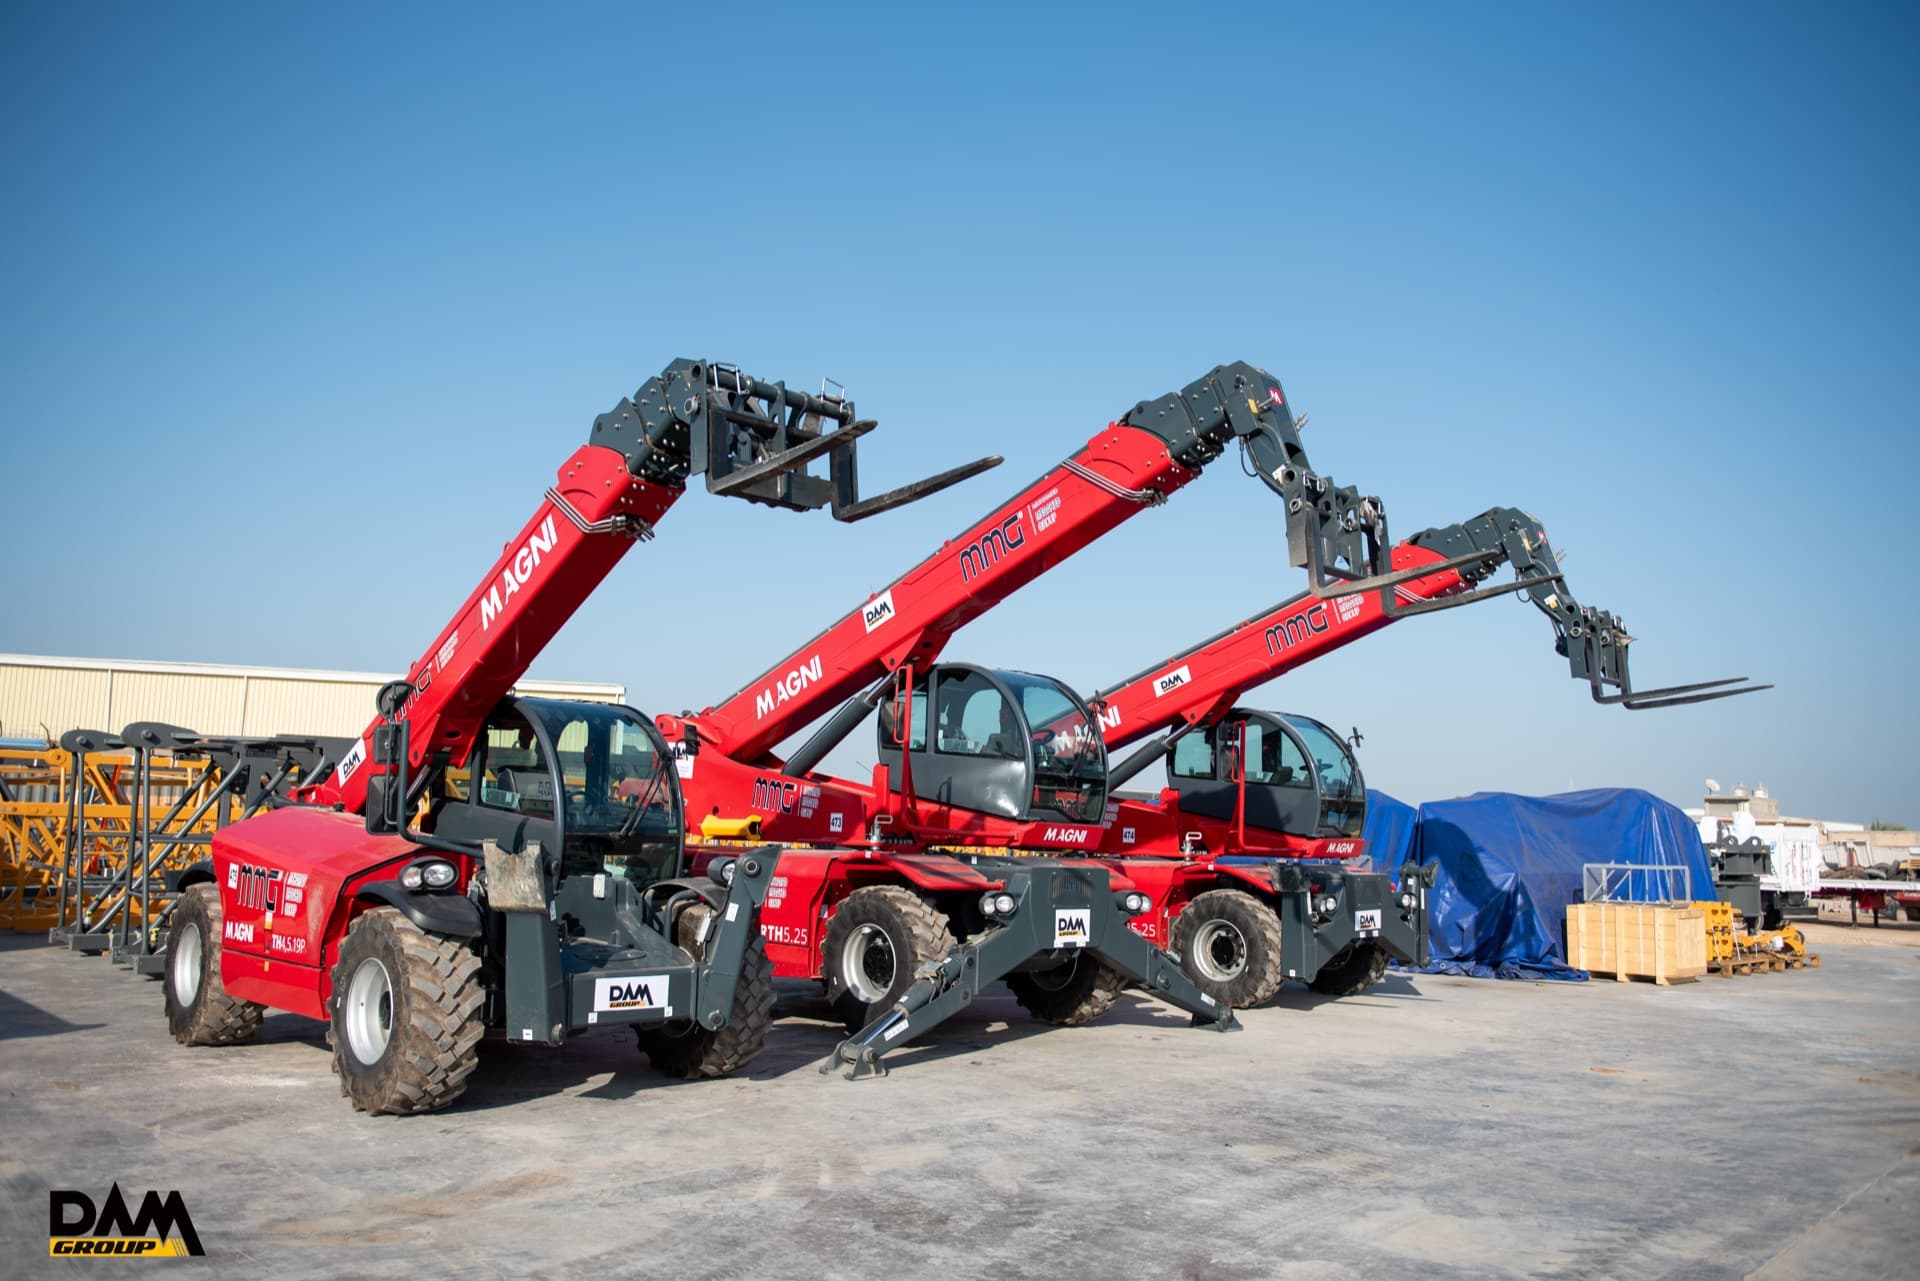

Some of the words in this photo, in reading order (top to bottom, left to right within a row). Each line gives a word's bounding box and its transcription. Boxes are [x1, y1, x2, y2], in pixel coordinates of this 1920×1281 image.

[480, 513, 558, 632] MAGNI
[866, 601, 892, 624] DAM
[755, 654, 823, 720] MAGNI
[1160, 674, 1185, 690] DAM
[343, 750, 361, 776] DAM
[831, 816, 841, 829] 473
[1043, 828, 1088, 843] MAGNI
[1326, 843, 1355, 854] MAGNI
[225, 921, 254, 943] MAGNI
[760, 924, 808, 945] RTH5.25
[1058, 915, 1087, 936] DAM
[609, 981, 654, 1006] DAM
